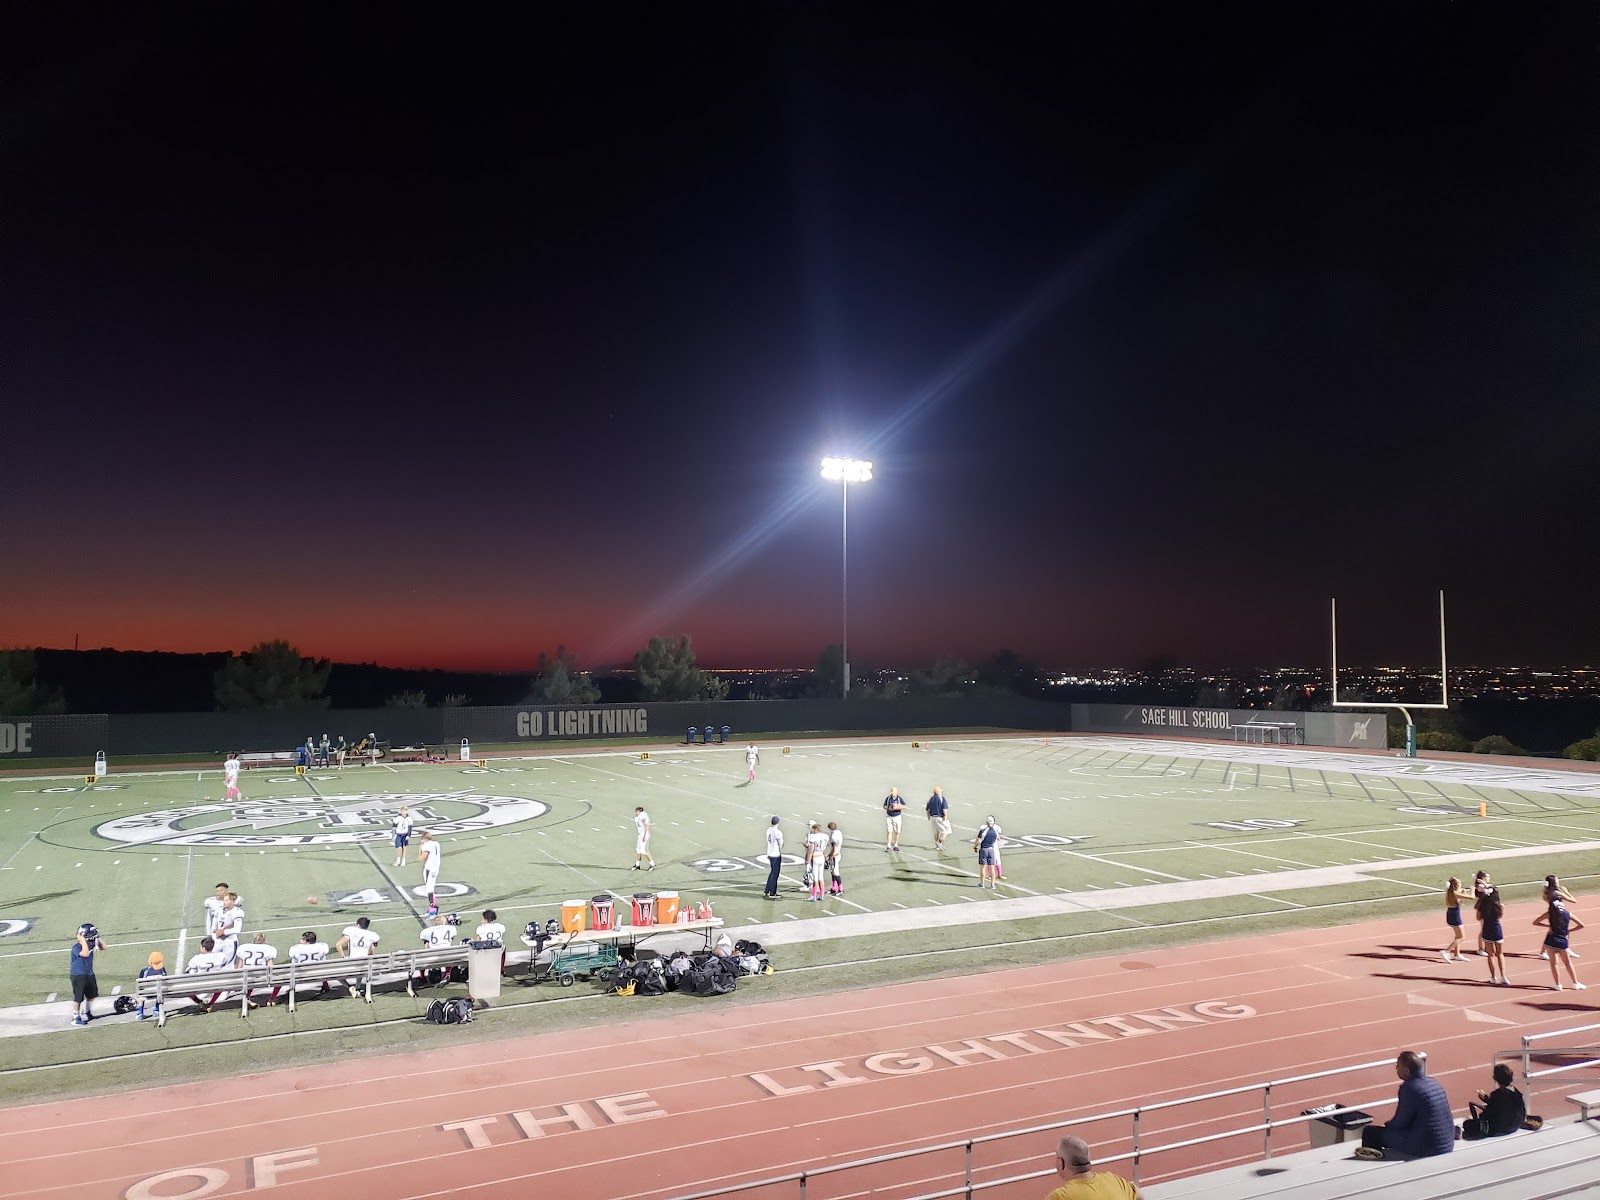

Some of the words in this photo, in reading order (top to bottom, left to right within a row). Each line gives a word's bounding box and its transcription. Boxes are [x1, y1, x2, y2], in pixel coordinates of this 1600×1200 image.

[517, 711, 543, 737] GO
[548, 708, 648, 736] LIGHTNING
[1141, 707, 1166, 726] SAGE
[1168, 709, 1189, 728] HILL
[1192, 711, 1232, 730] SCHOOL
[357, 935, 366, 948] 6
[122, 1146, 320, 1200] OF
[438, 1091, 669, 1149] THE
[748, 1000, 1257, 1097] LIGHTNING
